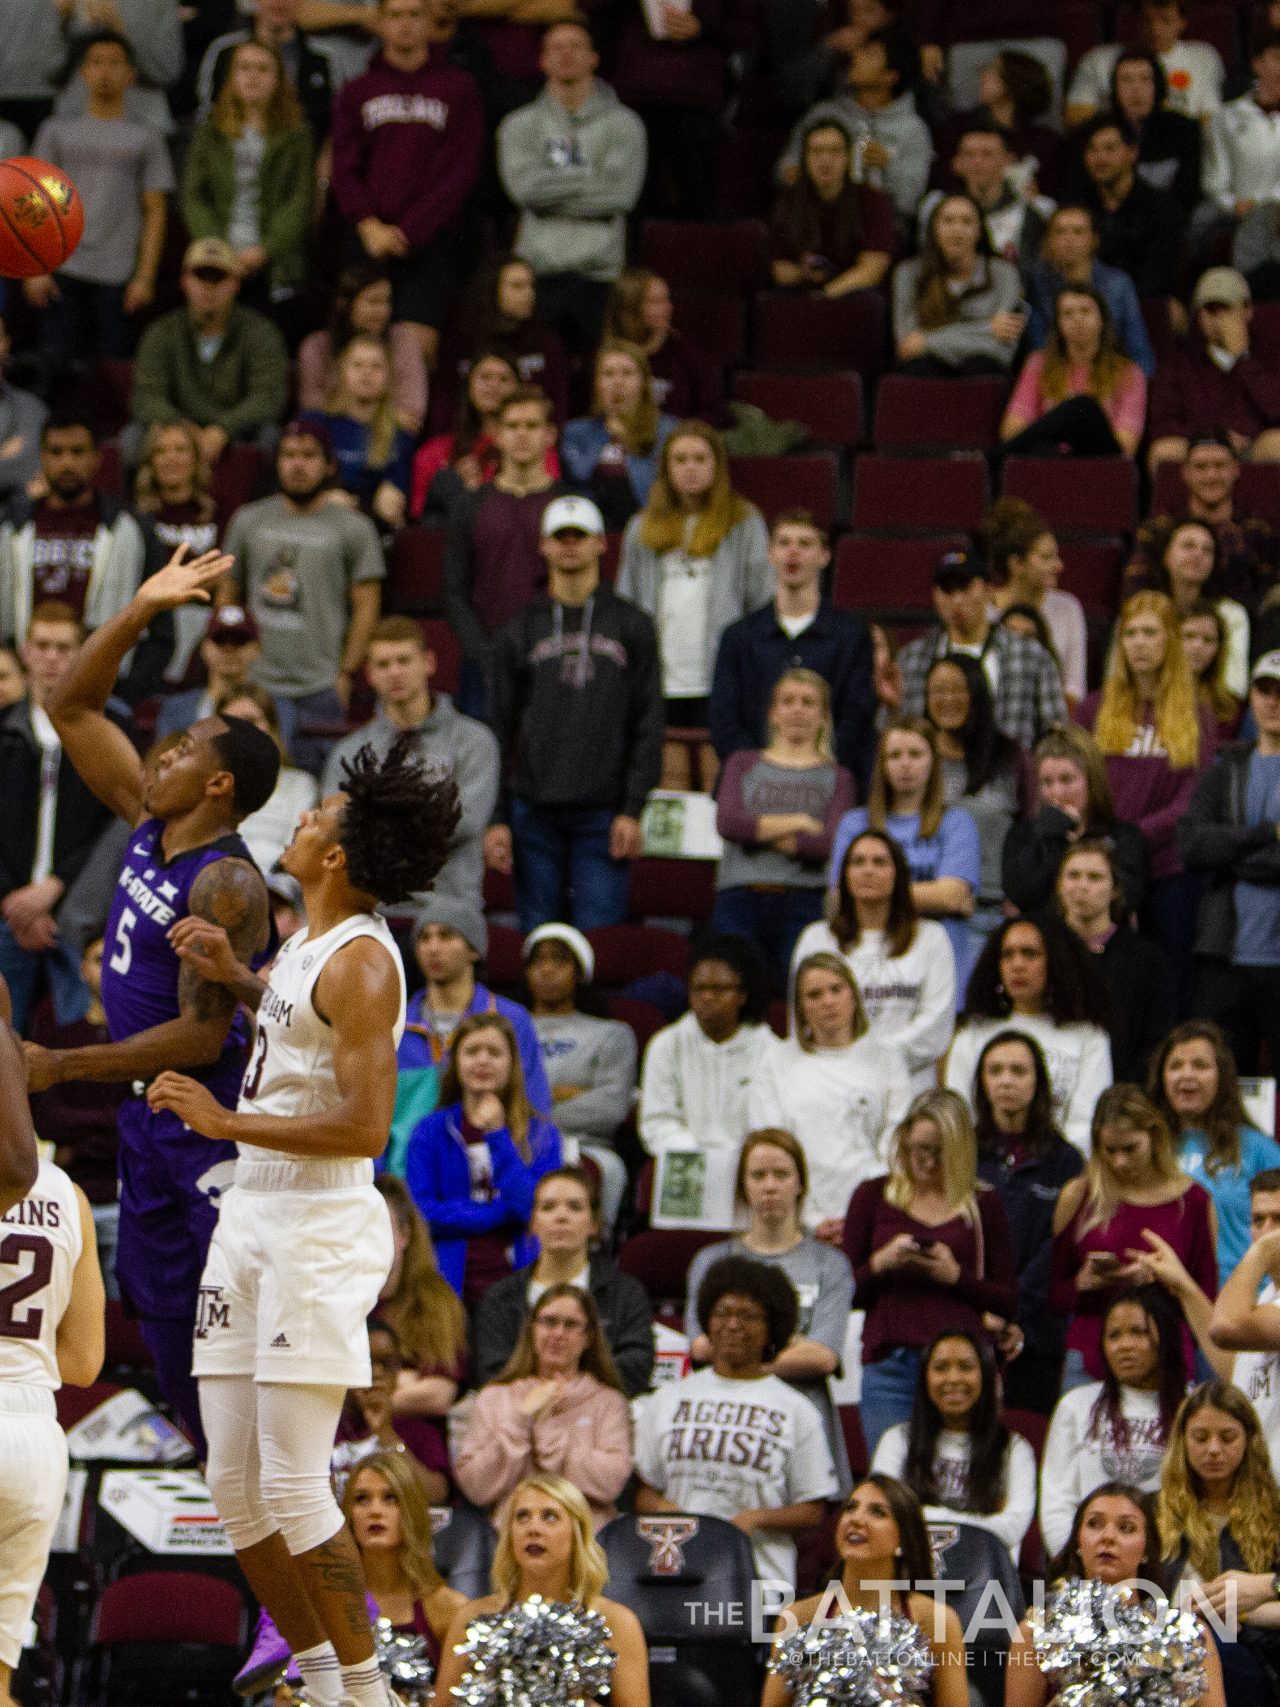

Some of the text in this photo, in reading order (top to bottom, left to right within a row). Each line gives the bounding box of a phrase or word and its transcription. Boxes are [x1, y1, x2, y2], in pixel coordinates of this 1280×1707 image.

[109, 907, 137, 975] 5
[672, 1399, 786, 1437] AGGIES
[666, 1428, 782, 1472] ARISE
